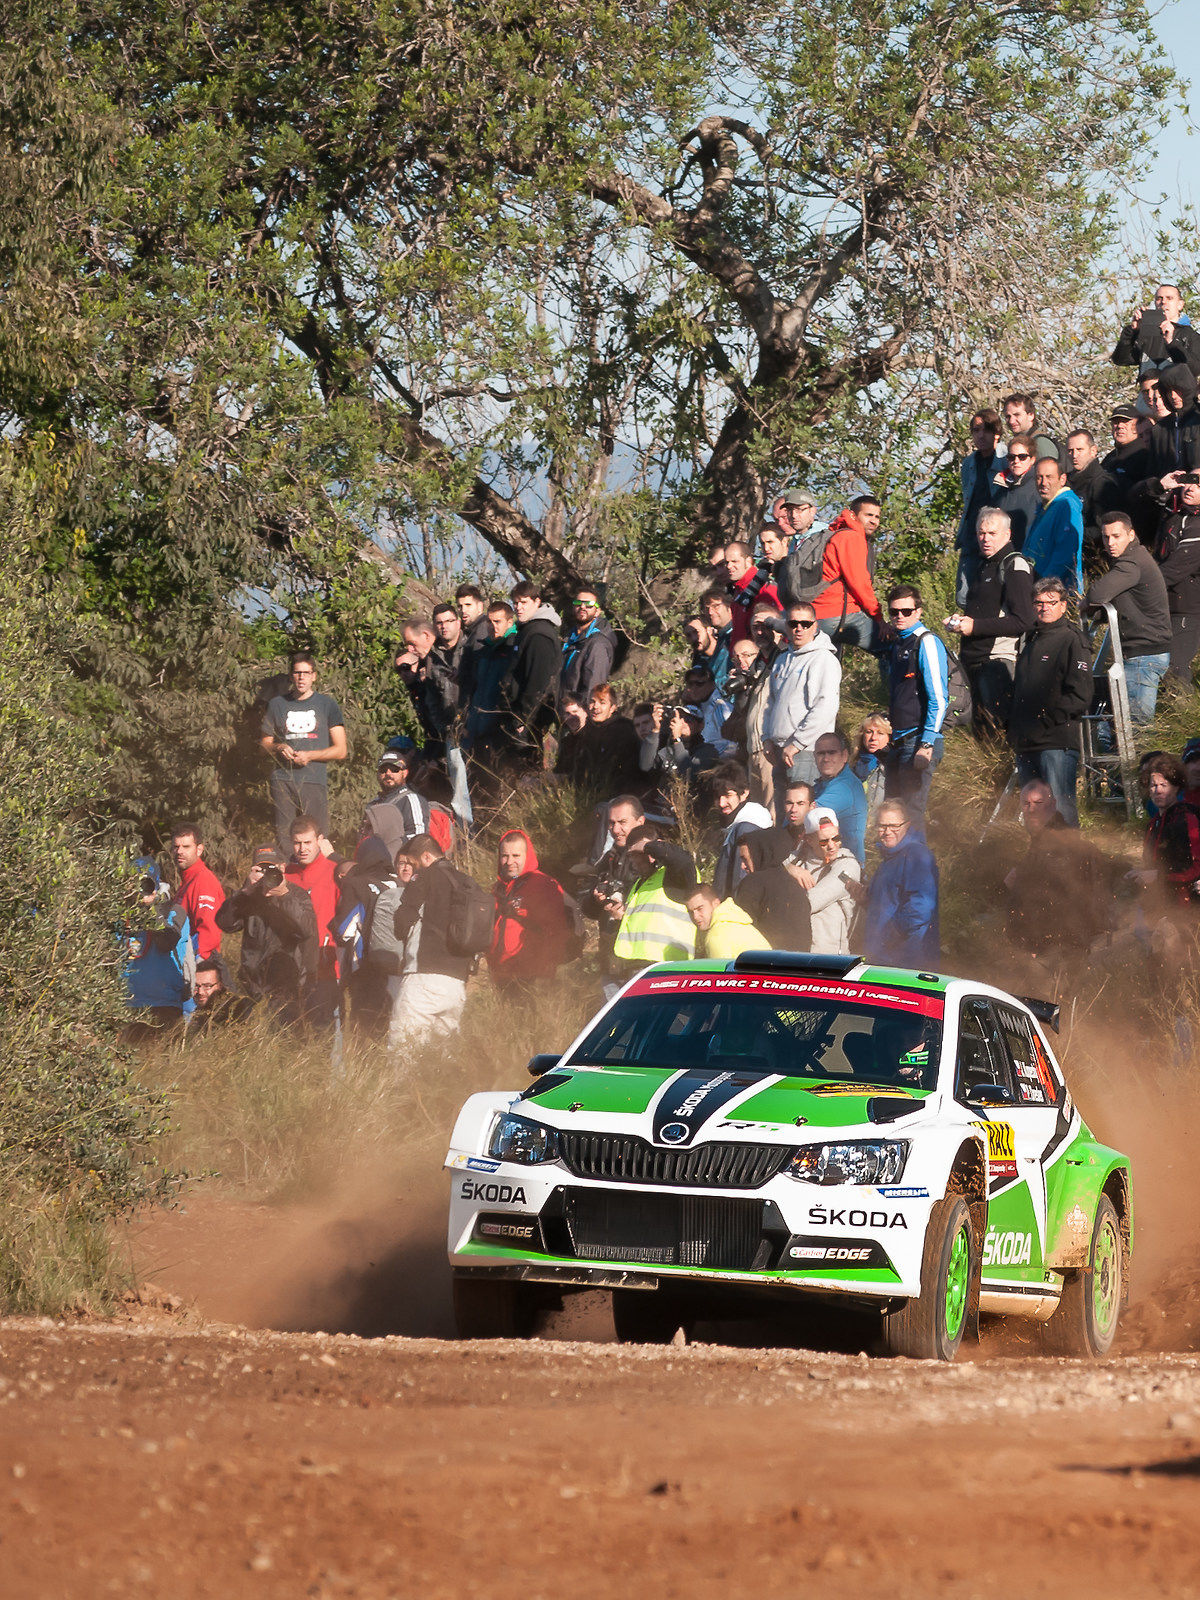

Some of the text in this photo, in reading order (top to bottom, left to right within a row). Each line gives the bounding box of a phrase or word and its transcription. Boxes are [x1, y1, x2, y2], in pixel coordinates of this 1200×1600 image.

[688, 979, 712, 988] FIA
[715, 979, 747, 988] WRC
[749, 980, 760, 988] 2
[762, 979, 857, 997] Championship
[461, 1179, 527, 1204] ŠKODA
[808, 1203, 908, 1229] ŠKODA
[500, 1225, 535, 1238] EDGE
[824, 1247, 873, 1261] EDGE
[981, 1224, 1032, 1266] ŠKODA
